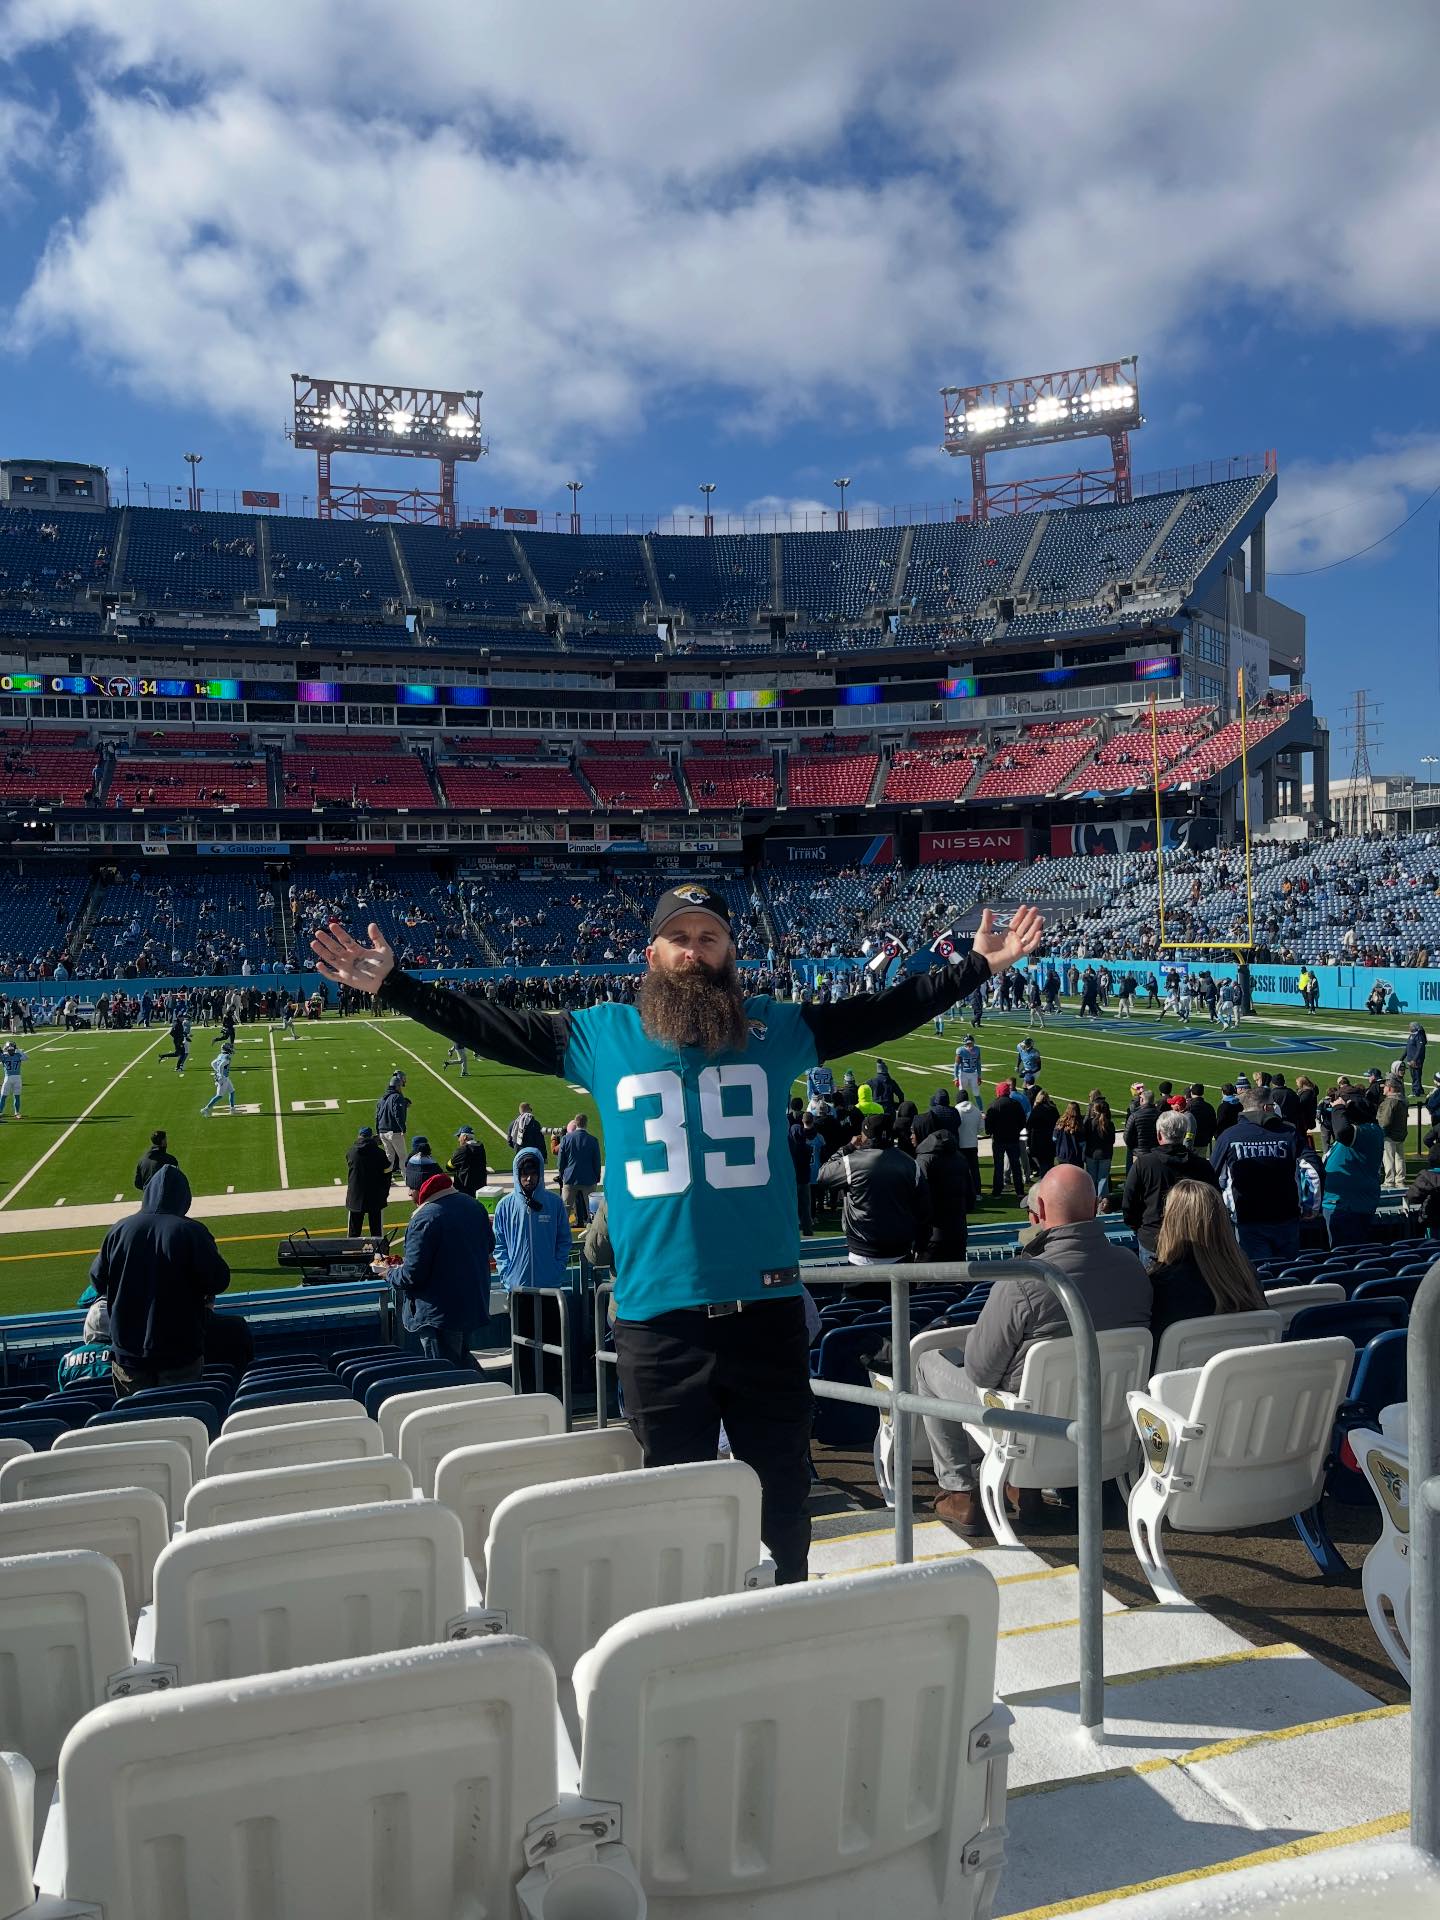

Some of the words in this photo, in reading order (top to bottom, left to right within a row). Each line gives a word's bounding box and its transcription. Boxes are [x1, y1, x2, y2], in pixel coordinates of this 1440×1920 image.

[1, 677, 13, 690] 0
[52, 678, 64, 692] 0
[195, 683, 211, 694] 1st
[569, 844, 601, 852] Pinnacle
[932, 835, 1011, 849] NISSAN
[228, 844, 277, 855] Gallagher
[786, 845, 826, 861] TITANS
[615, 1063, 771, 1200] 39
[1230, 1140, 1288, 1160] TITANS
